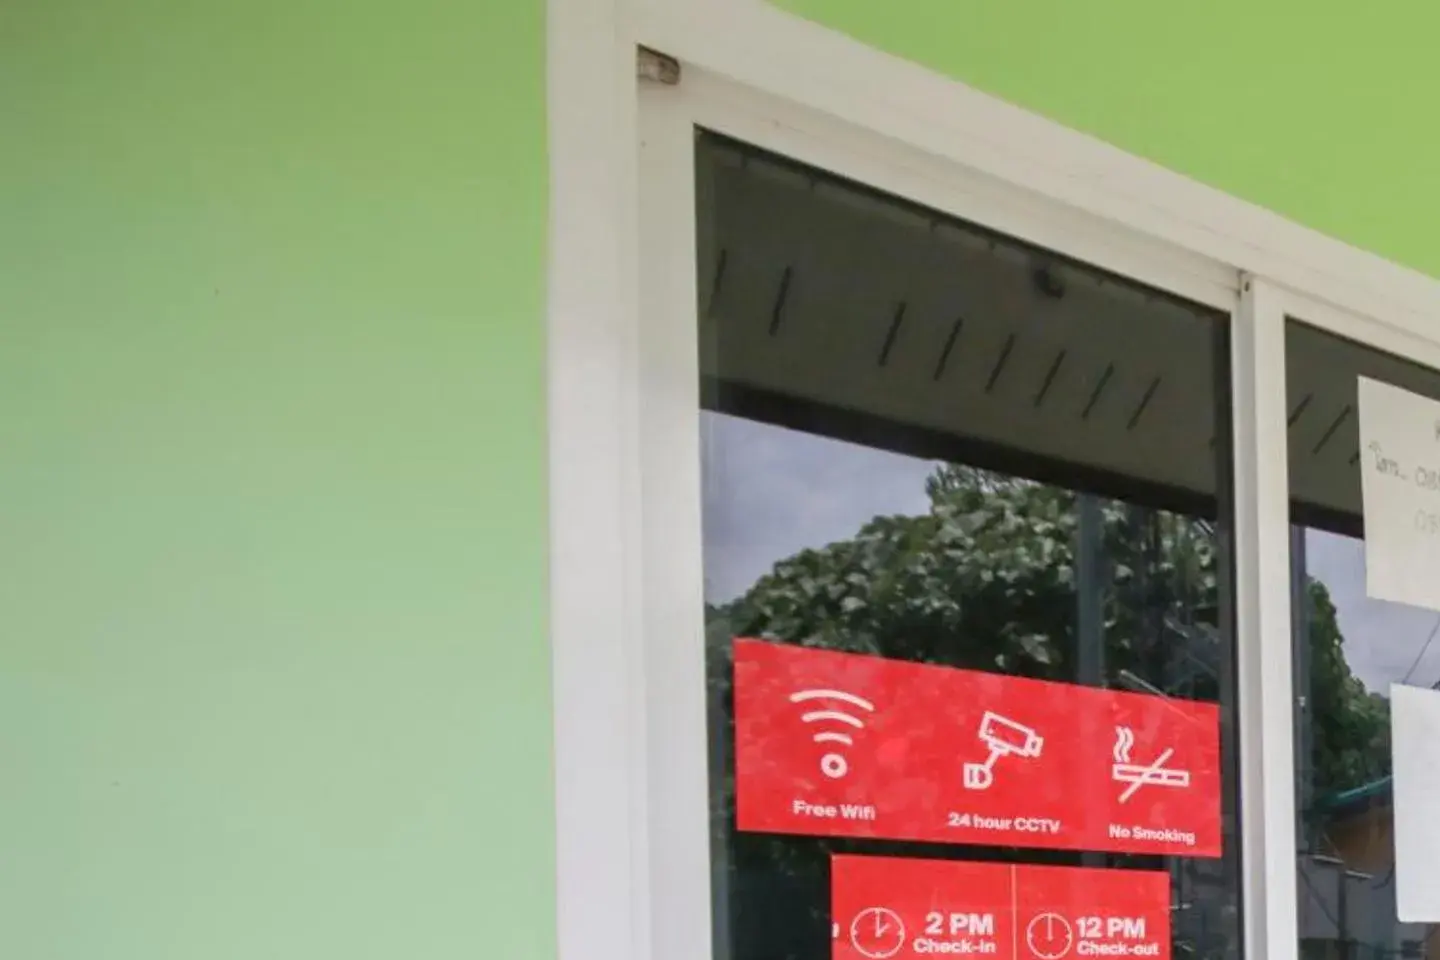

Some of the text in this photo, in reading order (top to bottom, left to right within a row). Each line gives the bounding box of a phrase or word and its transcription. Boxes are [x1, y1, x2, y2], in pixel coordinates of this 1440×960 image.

[793, 800, 876, 820] Free Wifi
[948, 812, 1060, 833] 24 hour CCTV
[1109, 824, 1196, 846] No Smoking
[925, 912, 994, 935] 2 PM
[1076, 917, 1145, 938] 12 PM
[913, 938, 996, 953] Check-in
[1077, 941, 1160, 956] Check-out
